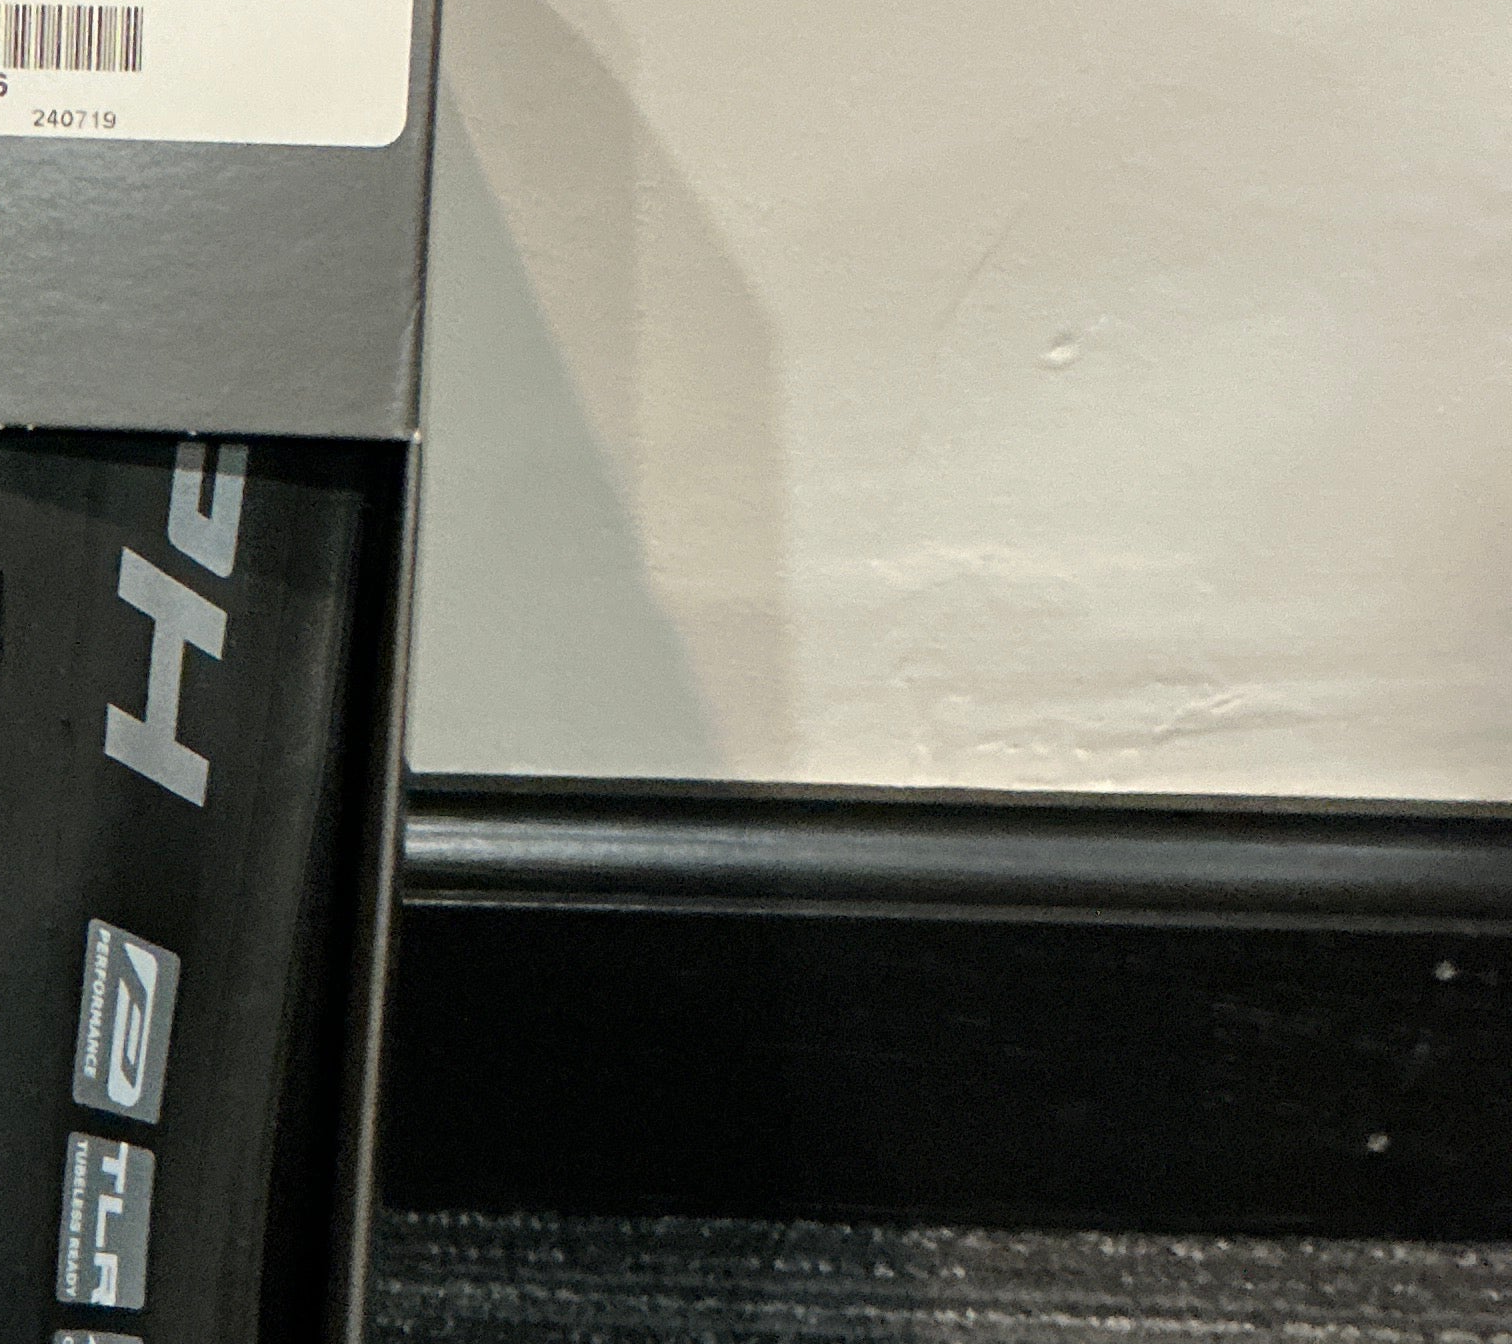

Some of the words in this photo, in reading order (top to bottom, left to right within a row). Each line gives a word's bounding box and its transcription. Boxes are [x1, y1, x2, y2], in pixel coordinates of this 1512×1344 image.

[32, 109, 117, 130] 240719
[83, 927, 111, 1079] PERFORMANCE
[66, 1140, 88, 1233] TUBELESS
[90, 1142, 129, 1307] TLR
[63, 1236, 81, 1299] READY
